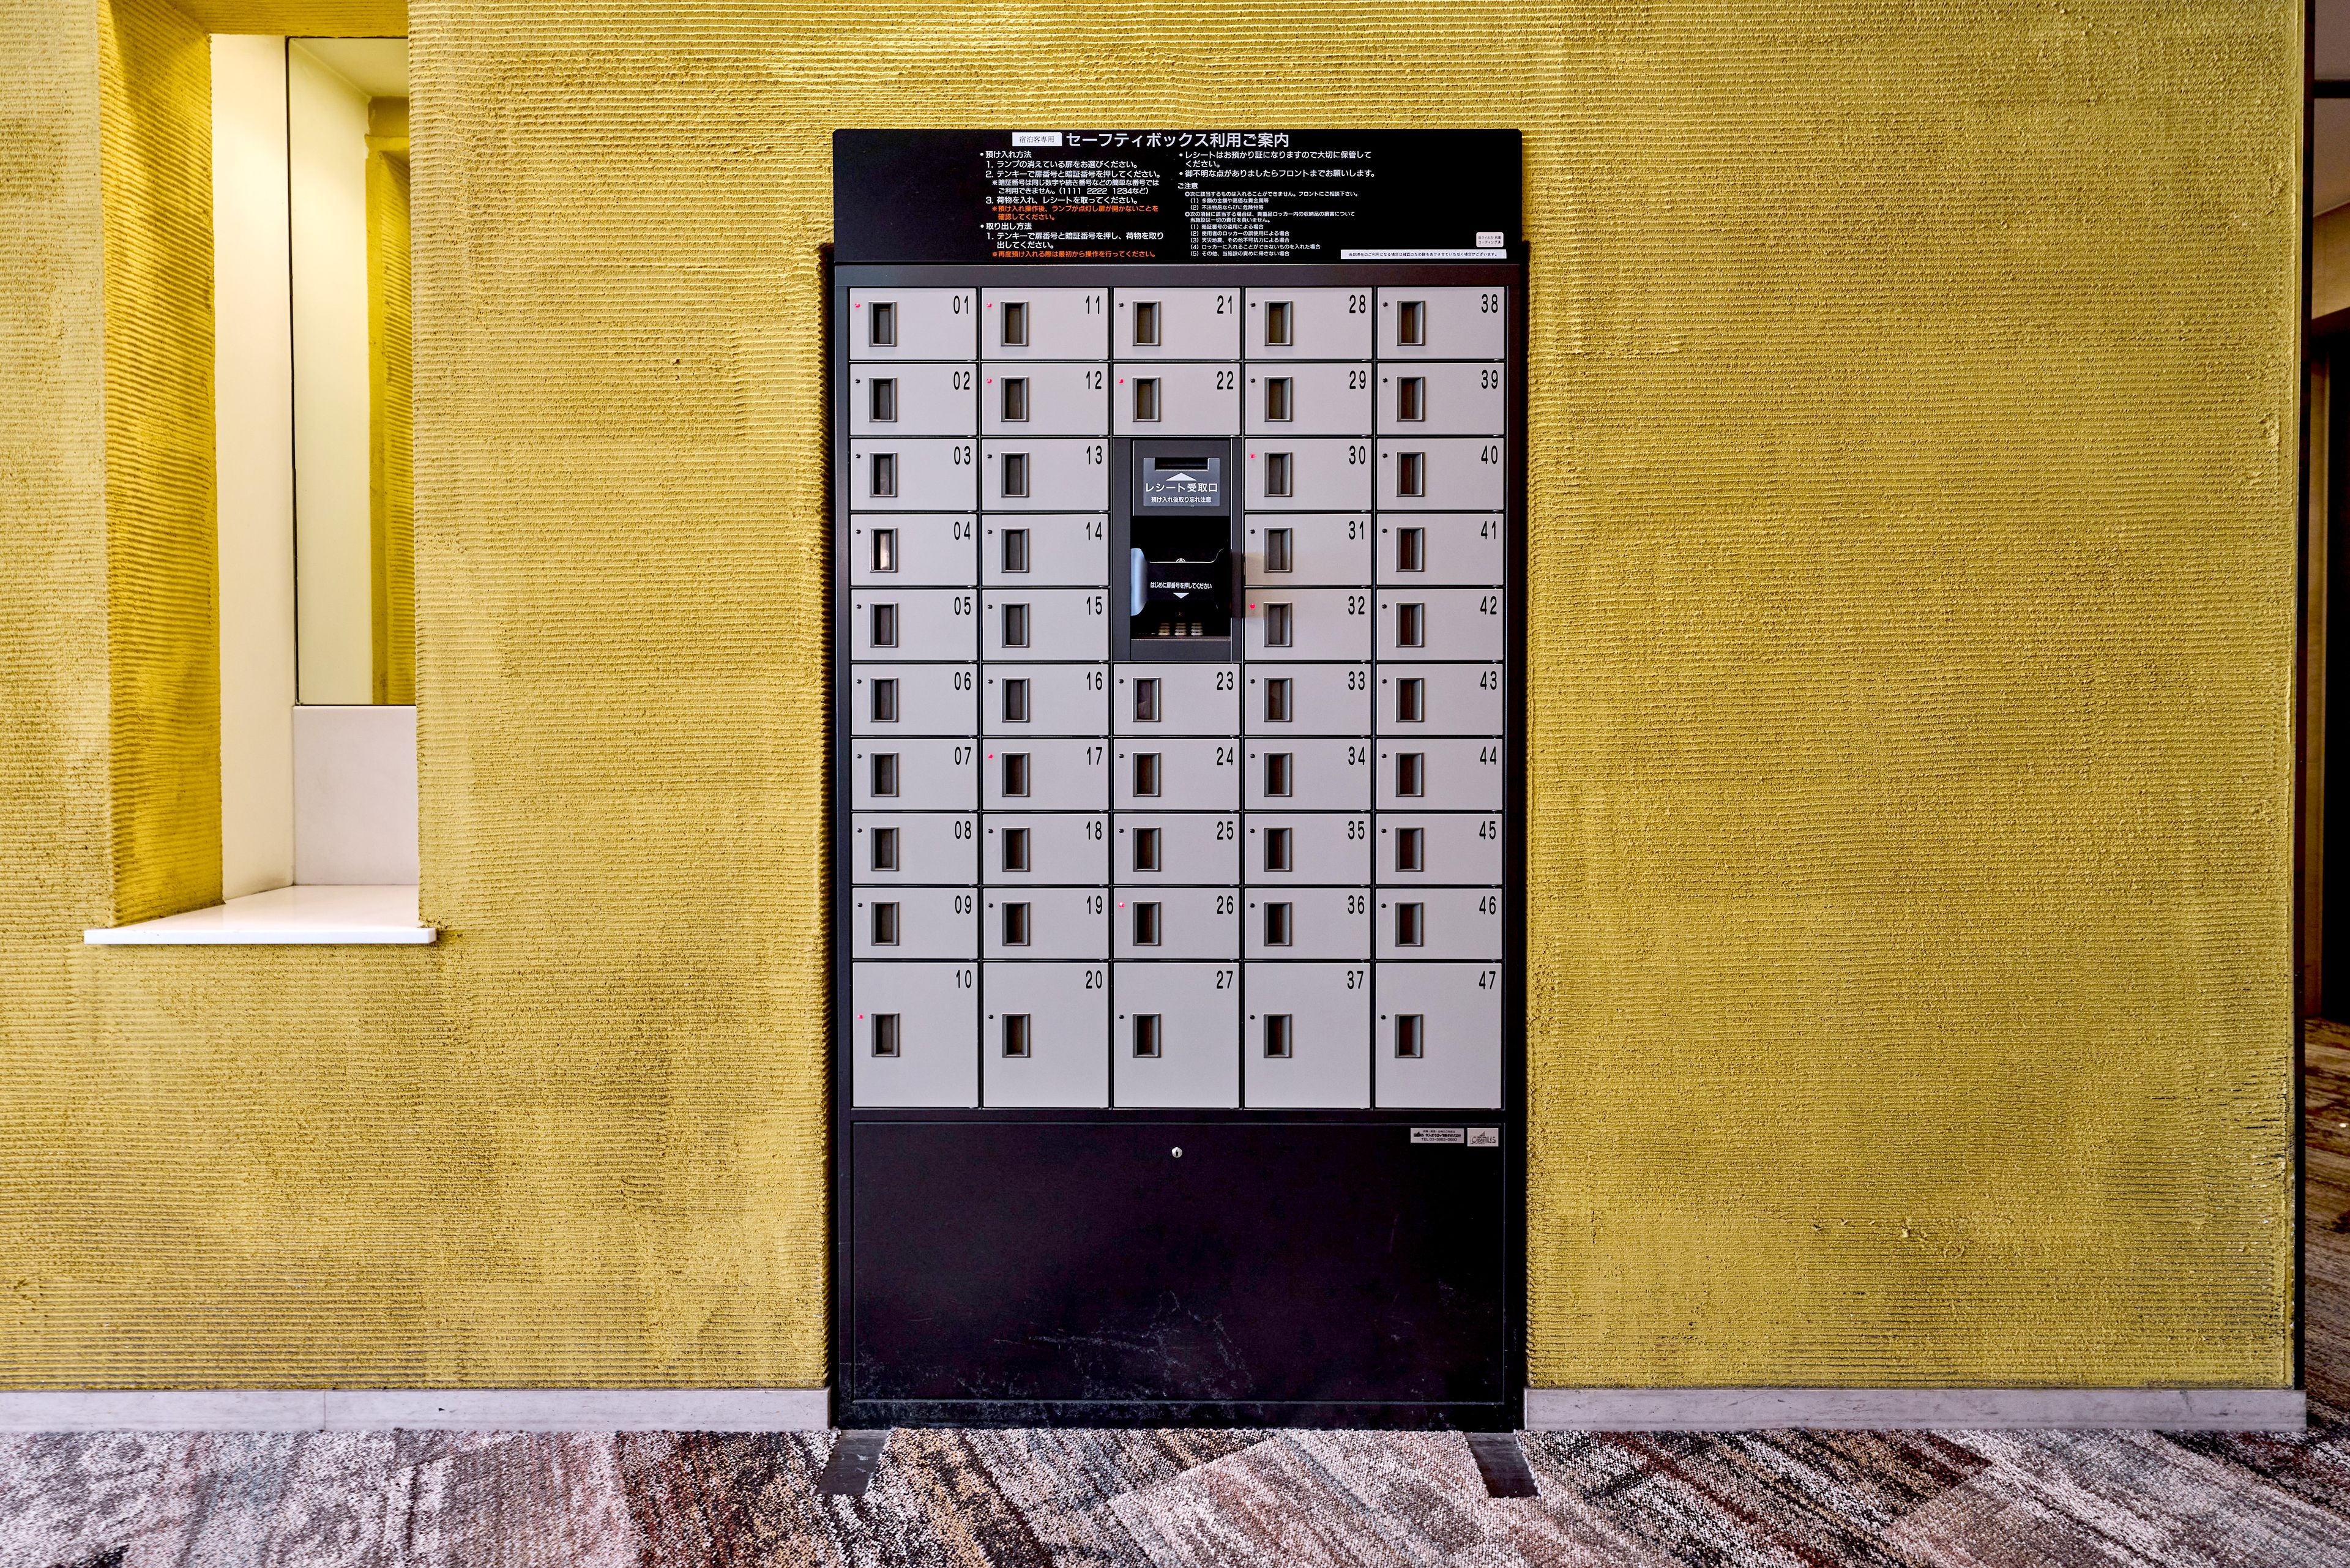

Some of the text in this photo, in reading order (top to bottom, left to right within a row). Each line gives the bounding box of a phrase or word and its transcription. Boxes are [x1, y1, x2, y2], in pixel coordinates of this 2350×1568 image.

[1066, 133, 1288, 147] セーフティボックス利用ご案内
[953, 295, 969, 315] 01
[1086, 295, 1100, 315] 11
[1217, 295, 1233, 315] 21
[1349, 294, 1366, 314] 28
[1481, 293, 1498, 313] 38
[953, 371, 971, 390] 02
[1086, 370, 1102, 390] 12
[1217, 370, 1234, 390] 22
[1349, 370, 1367, 390] 29
[1481, 369, 1498, 389] 39
[953, 446, 971, 465] 03
[1086, 445, 1102, 465] 13
[1348, 445, 1366, 465] 30
[1480, 445, 1498, 465] 40
[1146, 482, 1218, 493] レシート受取口
[953, 521, 971, 540] 04
[1086, 521, 1102, 541] 14
[1348, 520, 1364, 540] 31
[1480, 520, 1496, 540] 41
[954, 596, 971, 616] 05
[1086, 596, 1103, 616] 15
[1348, 595, 1365, 615] 32
[1480, 595, 1498, 615] 42
[954, 671, 971, 691] 06
[1086, 671, 1103, 691] 16
[1216, 671, 1234, 691] 23
[1348, 671, 1365, 690] 33
[1480, 670, 1498, 690] 43
[954, 746, 972, 766] 07
[1086, 746, 1103, 766] 17
[1216, 747, 1234, 766] 24
[1348, 746, 1365, 766] 34
[1479, 746, 1497, 766] 44
[954, 820, 972, 840] 08
[1086, 821, 1102, 840] 18
[1217, 821, 1234, 840] 25
[1348, 820, 1365, 840] 35
[1479, 820, 1496, 840] 45
[955, 895, 972, 914] 09
[1086, 895, 1103, 915] 19
[1217, 895, 1234, 915] 26
[1347, 895, 1365, 915] 36
[1479, 895, 1496, 916] 46
[956, 969, 972, 989] 10
[1085, 969, 1103, 989] 20
[1216, 970, 1234, 990] 27
[1347, 970, 1364, 990] 37
[1479, 970, 1496, 990] 47
